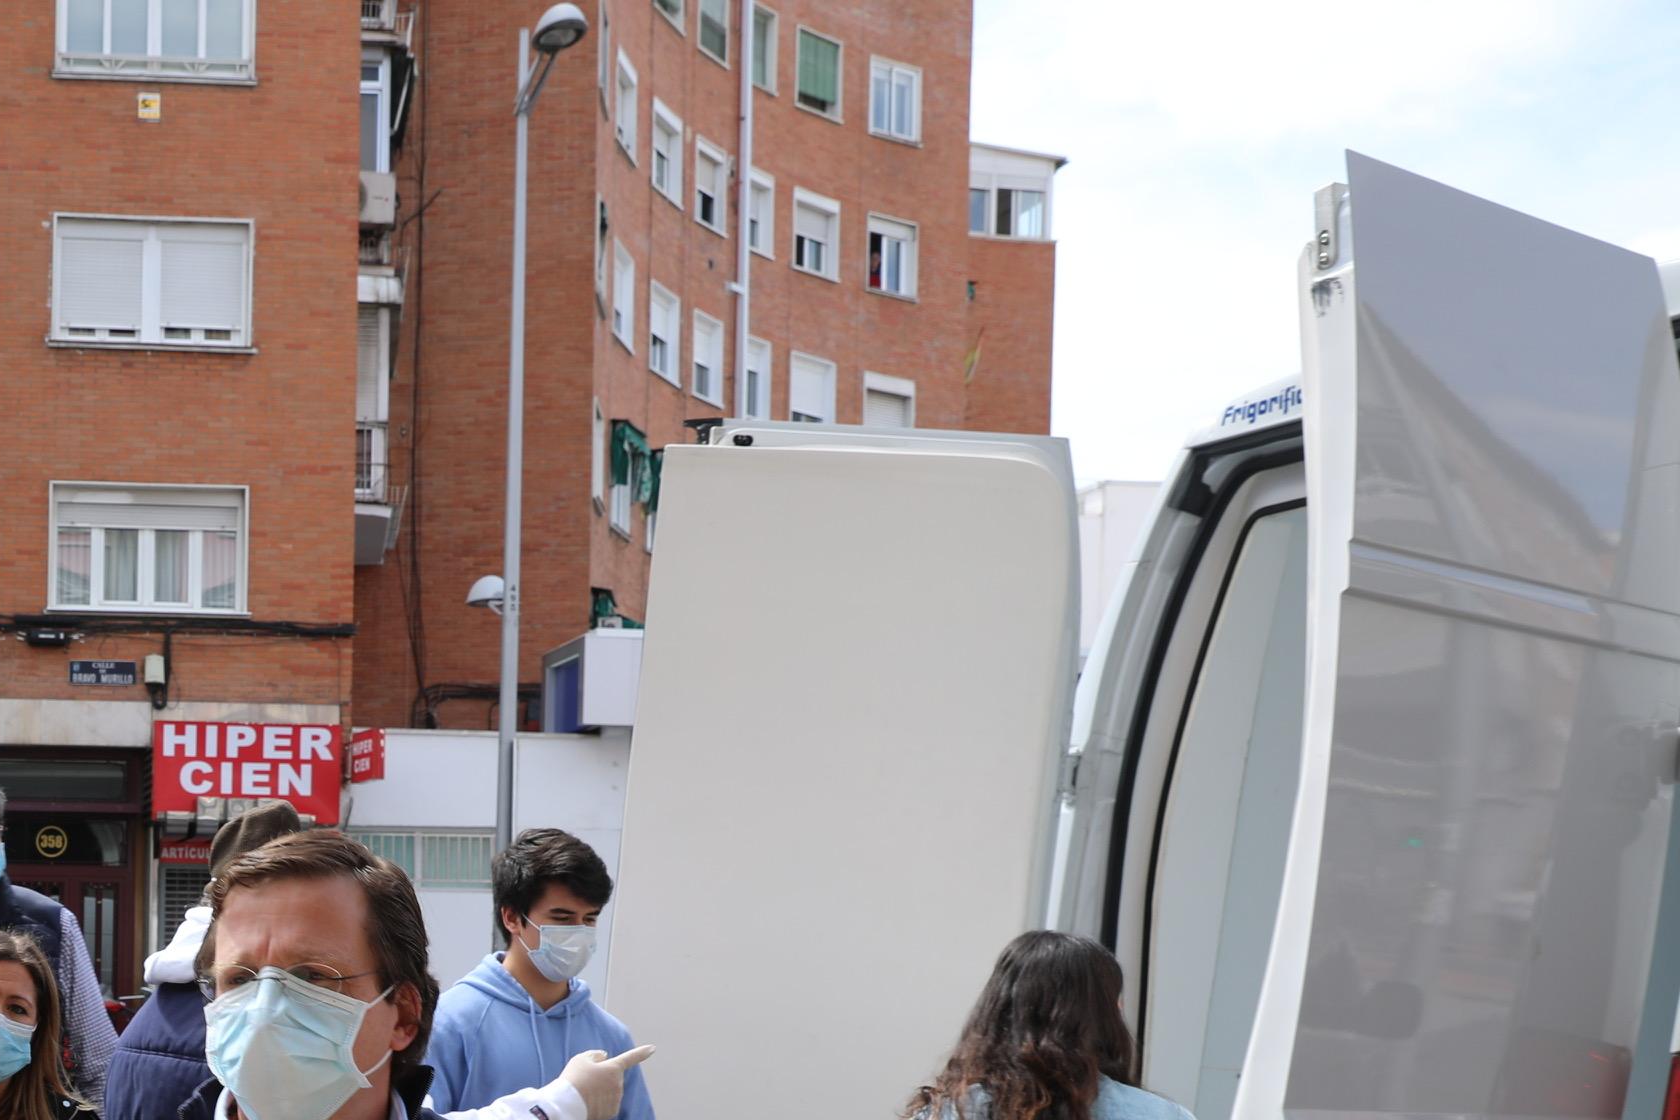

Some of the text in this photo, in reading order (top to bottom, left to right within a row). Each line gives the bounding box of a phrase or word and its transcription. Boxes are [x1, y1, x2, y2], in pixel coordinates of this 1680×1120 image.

[72, 673, 134, 684] BRAVO MURILLO
[162, 723, 334, 760] HIPER
[352, 739, 373, 756] HIPER
[354, 757, 370, 773] CIEN
[179, 760, 312, 797] CIEN
[40, 835, 63, 848] 358
[161, 845, 210, 859] ARTÍCUL
